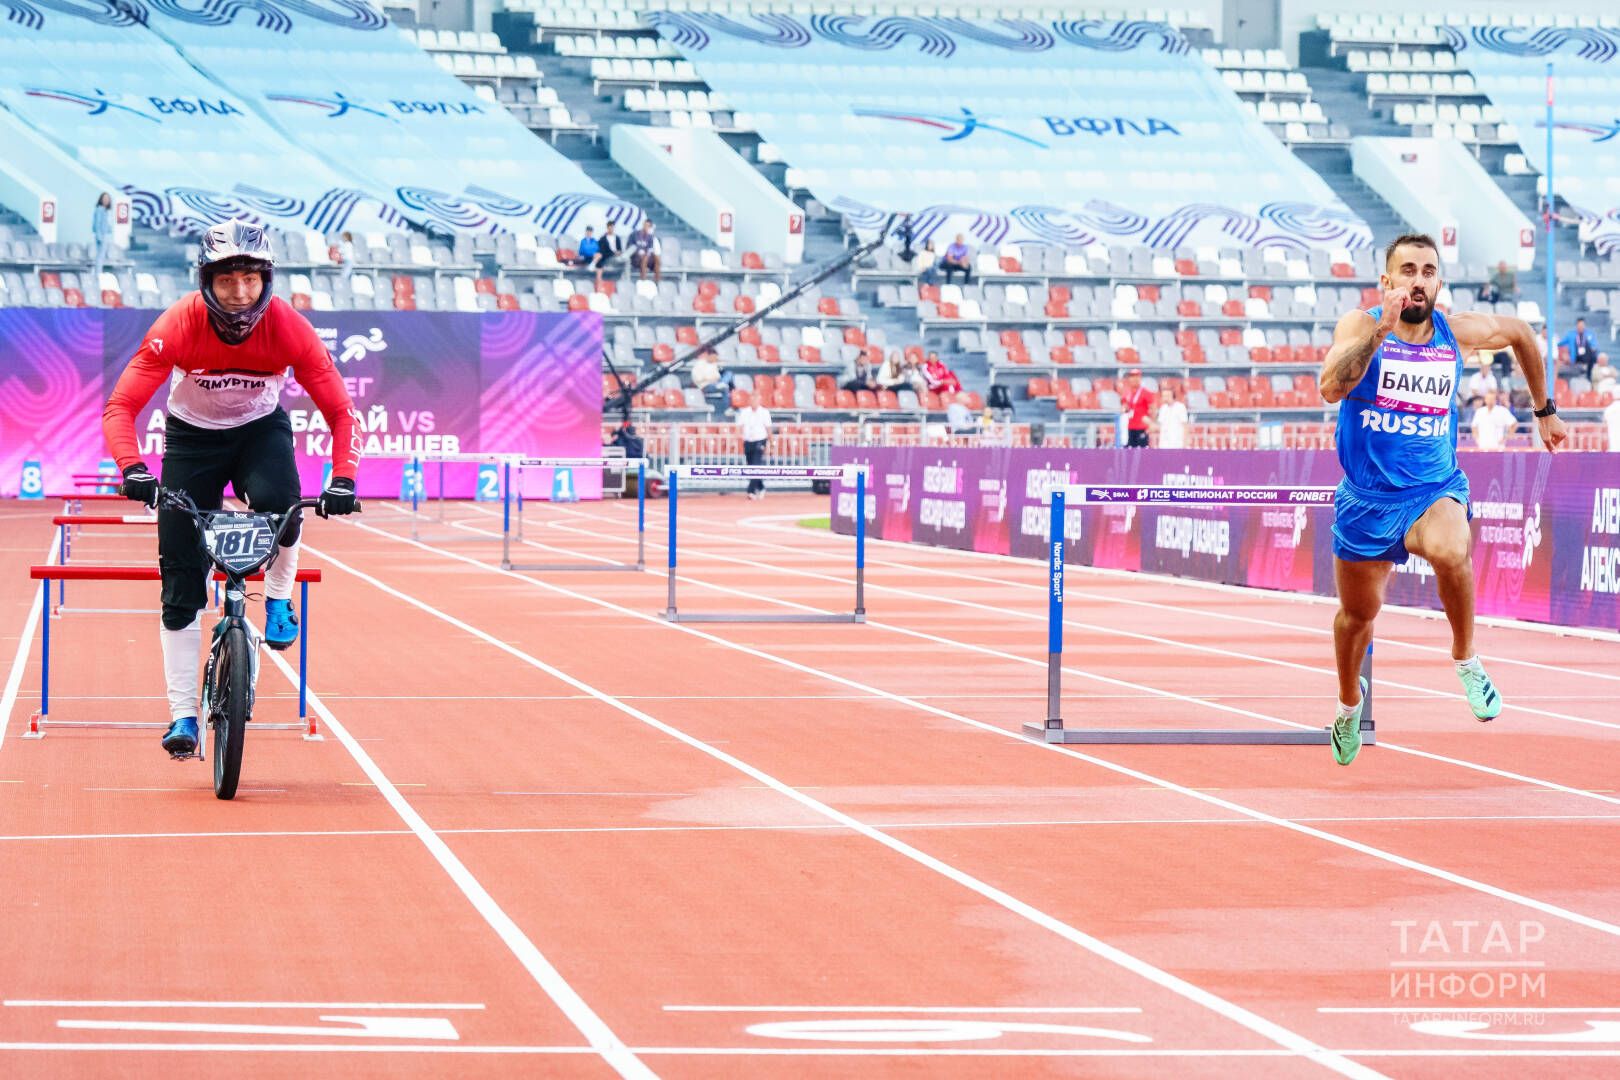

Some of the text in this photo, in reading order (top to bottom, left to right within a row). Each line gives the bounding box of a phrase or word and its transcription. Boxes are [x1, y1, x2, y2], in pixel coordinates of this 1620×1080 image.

[149, 95, 246, 117] ВФЛА
[390, 98, 486, 116] ВФЛА
[1043, 115, 1181, 137] ВФЛА
[792, 215, 801, 230] 7
[1382, 371, 1451, 396] БАКАЙ
[289, 404, 436, 433] БААЙ VS
[22, 466, 42, 493] 8
[479, 469, 499, 497] 2
[555, 470, 571, 497] 1
[1150, 490, 1334, 501] ПСБ ЧЕМПИОНАТ РОССИИ FONBET
[214, 530, 254, 557] 181
[1053, 541, 1063, 572] Nordic
